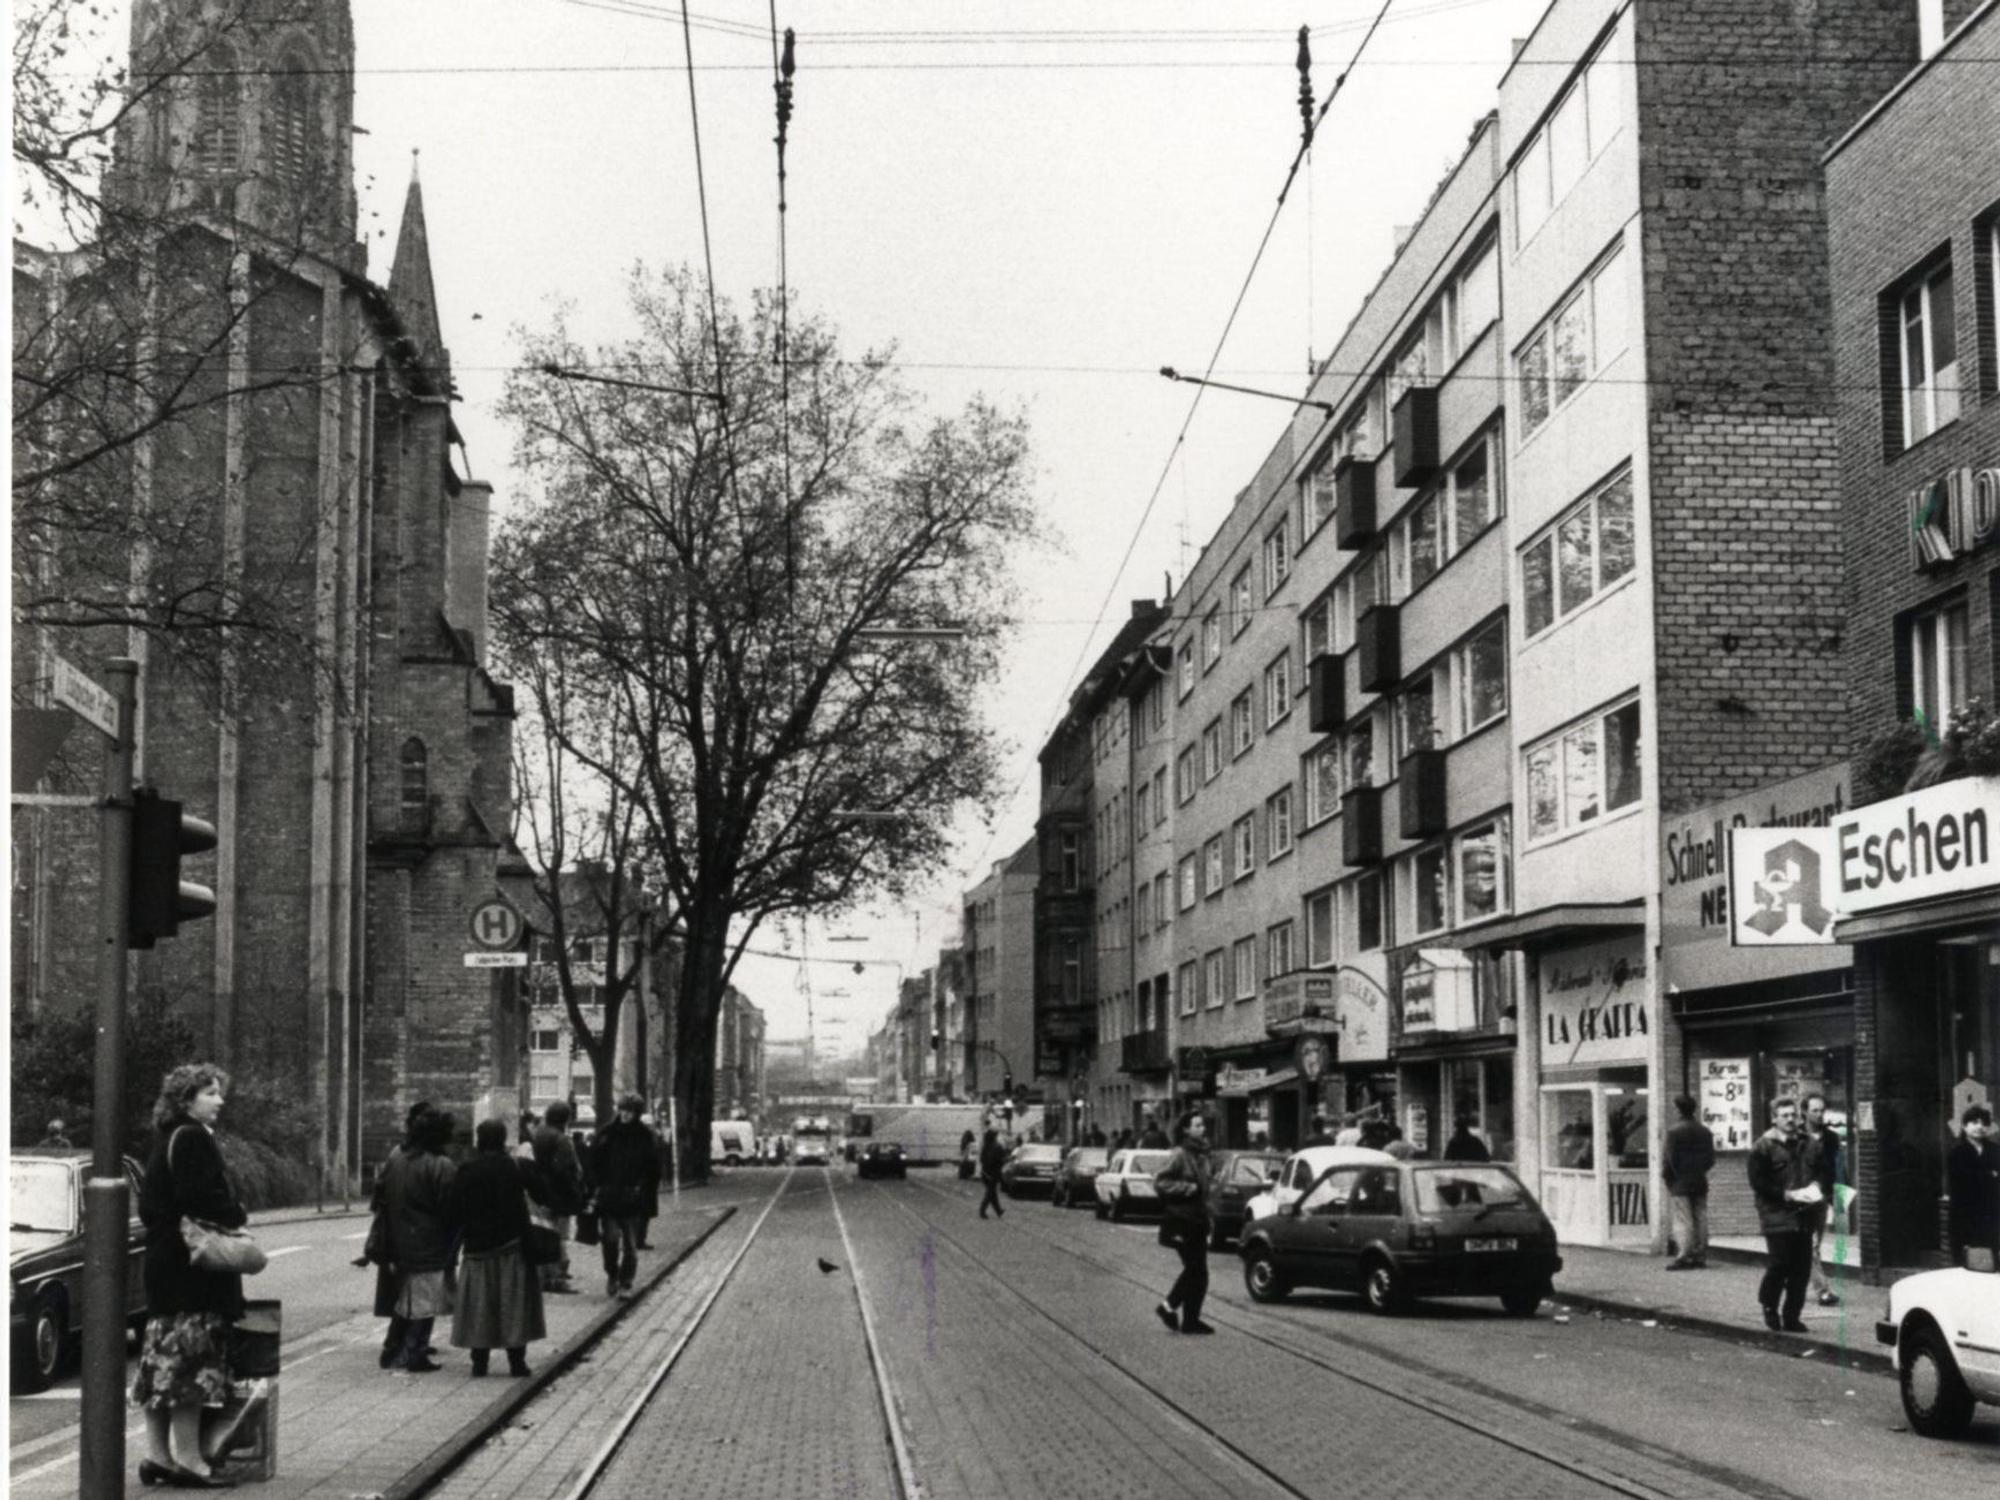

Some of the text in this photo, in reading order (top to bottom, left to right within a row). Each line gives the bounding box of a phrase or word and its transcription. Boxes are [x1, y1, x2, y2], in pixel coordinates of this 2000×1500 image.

[1667, 819, 1725, 886] Schnell
[1838, 806, 1989, 893] Eschen
[482, 909, 508, 941] H
[1548, 1012, 1571, 1045] LA
